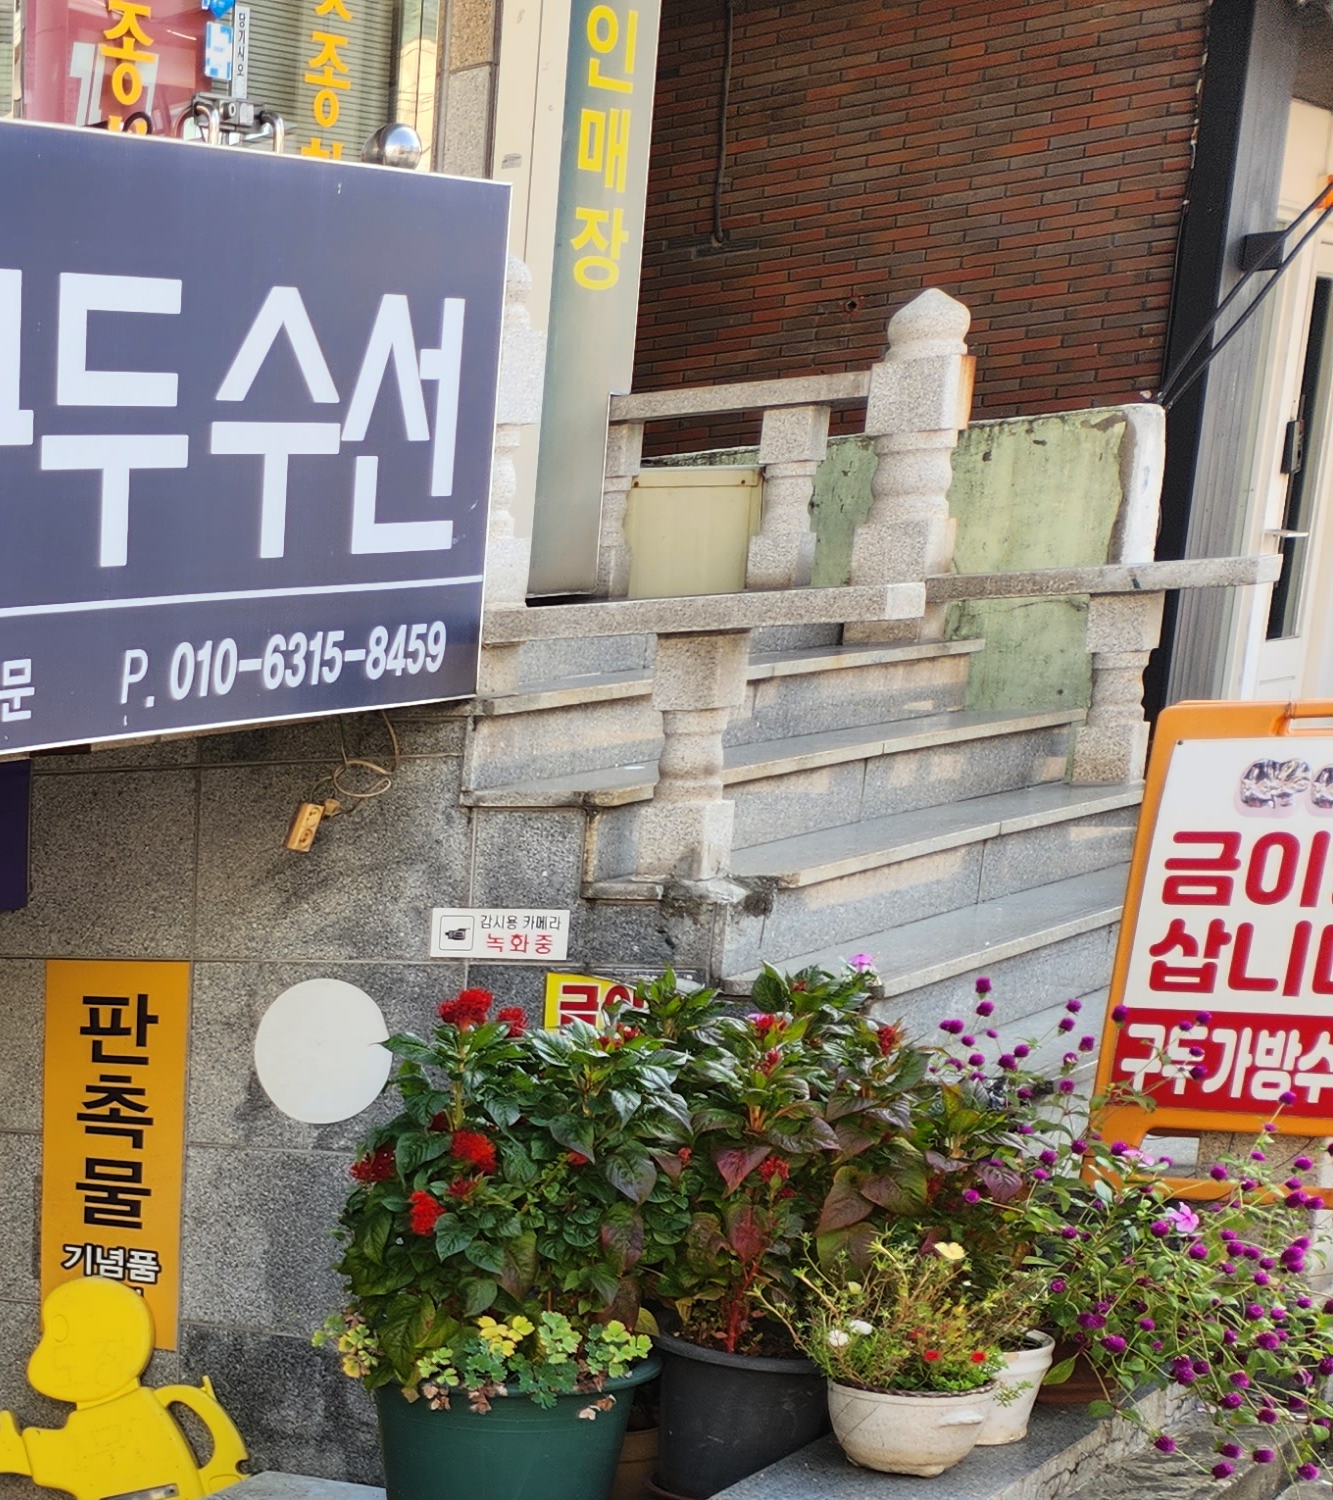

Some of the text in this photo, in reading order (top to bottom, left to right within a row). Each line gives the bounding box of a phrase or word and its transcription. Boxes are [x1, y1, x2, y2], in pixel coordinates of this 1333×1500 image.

[570, 3, 639, 291] 인매장
[168, 618, 447, 699] 010-6315-8459
[1161, 829, 1333, 908] 금이
[480, 914, 562, 931] 감시용 카메라
[75, 991, 160, 1230] 판촉물
[61, 1242, 162, 1286] 기념품
